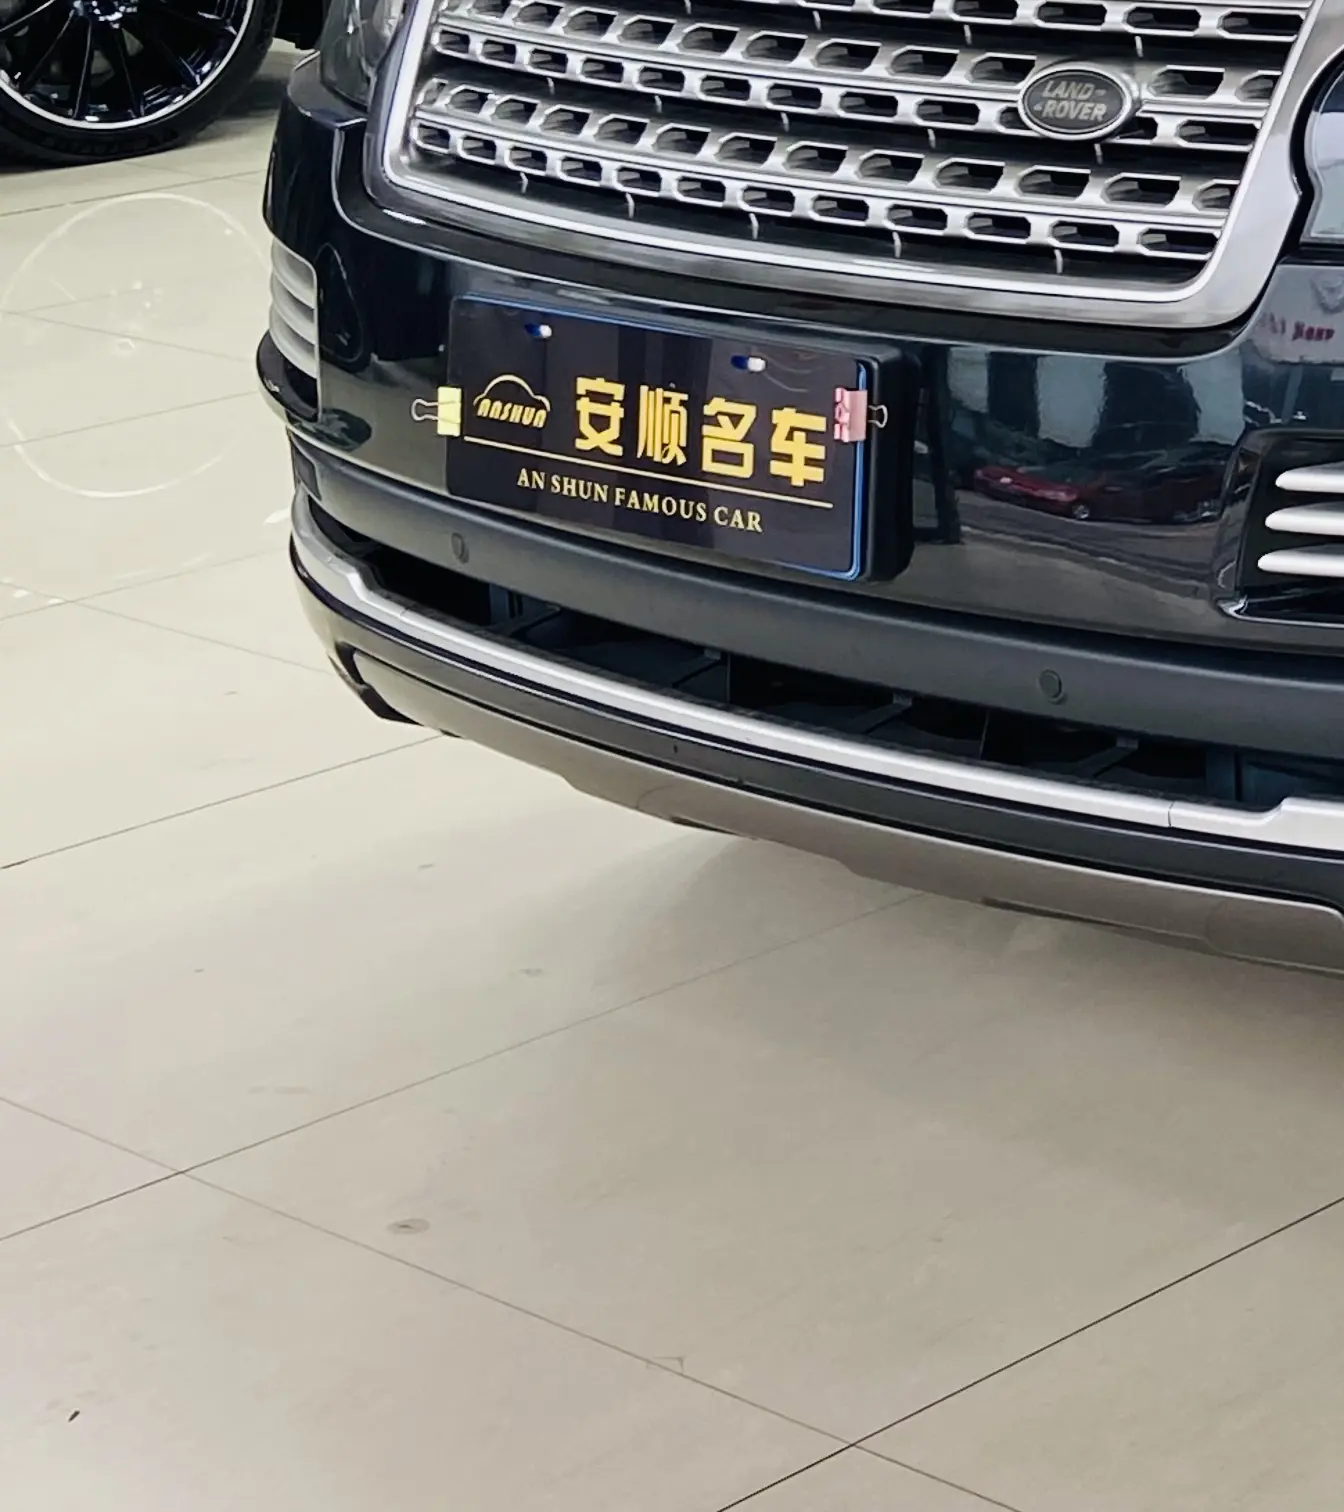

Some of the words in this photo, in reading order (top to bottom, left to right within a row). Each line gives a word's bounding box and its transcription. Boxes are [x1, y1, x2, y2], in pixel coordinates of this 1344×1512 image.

[1041, 99, 1108, 121] ROVER
[573, 376, 828, 488] 安顺名车
[516, 467, 547, 491] AN
[550, 473, 610, 504] SHUN
[614, 487, 707, 523] FAMOUS
[713, 505, 764, 534] CAR
